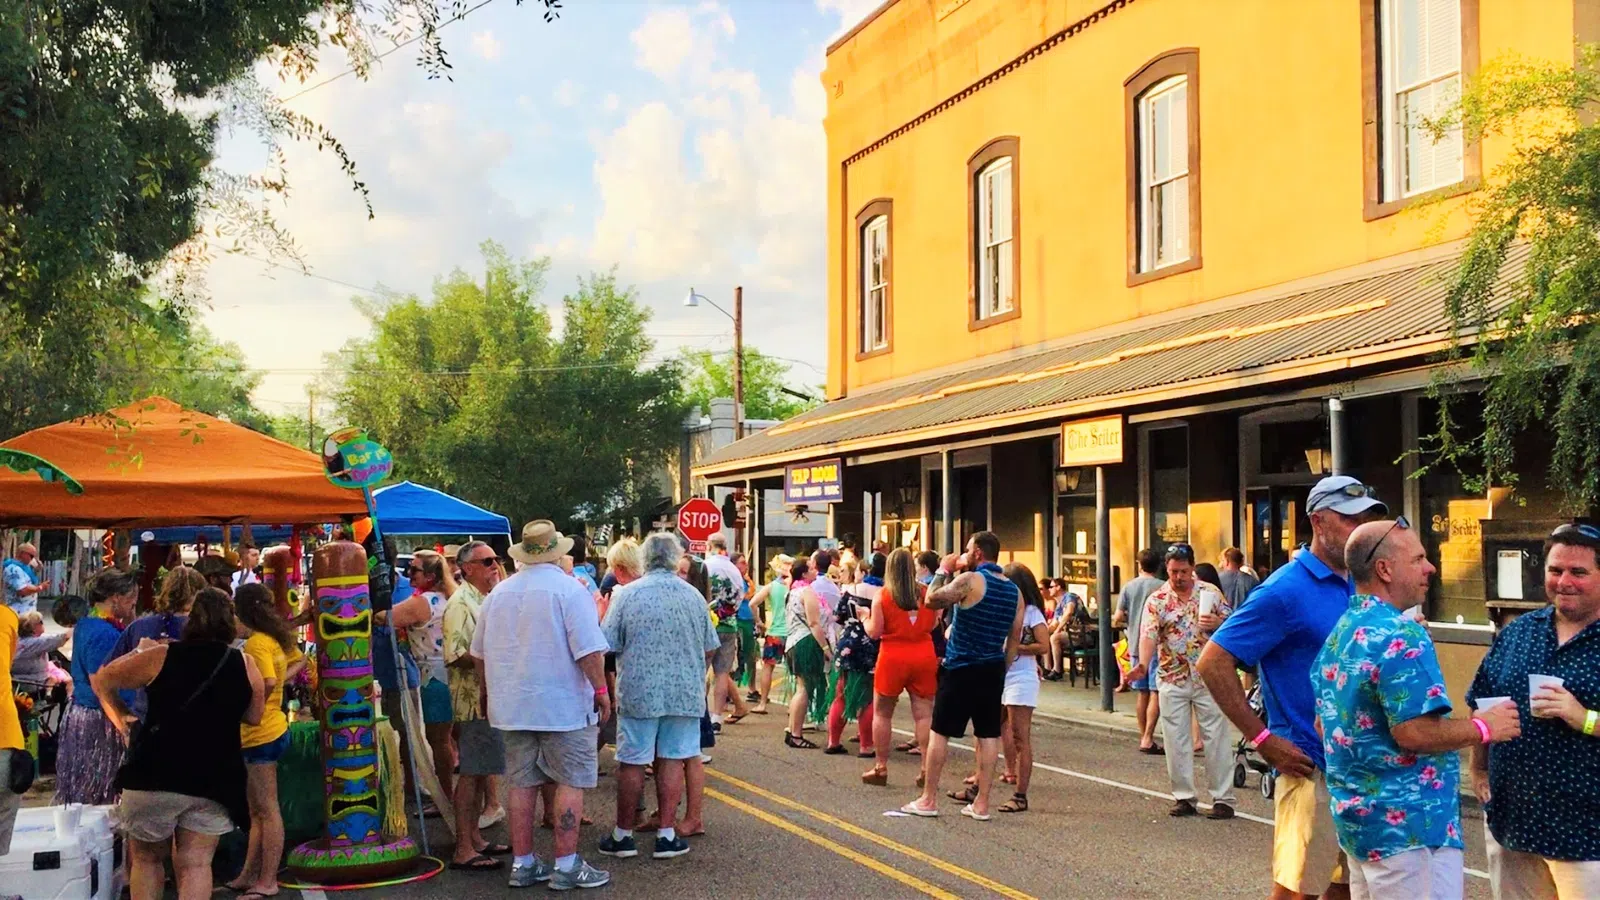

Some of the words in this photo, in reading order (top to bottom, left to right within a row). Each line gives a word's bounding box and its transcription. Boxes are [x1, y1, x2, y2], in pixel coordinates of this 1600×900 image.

[1067, 428, 1087, 451] The
[1090, 426, 1120, 448] Seiler
[791, 467, 810, 484] TAP
[681, 511, 719, 529] STOP
